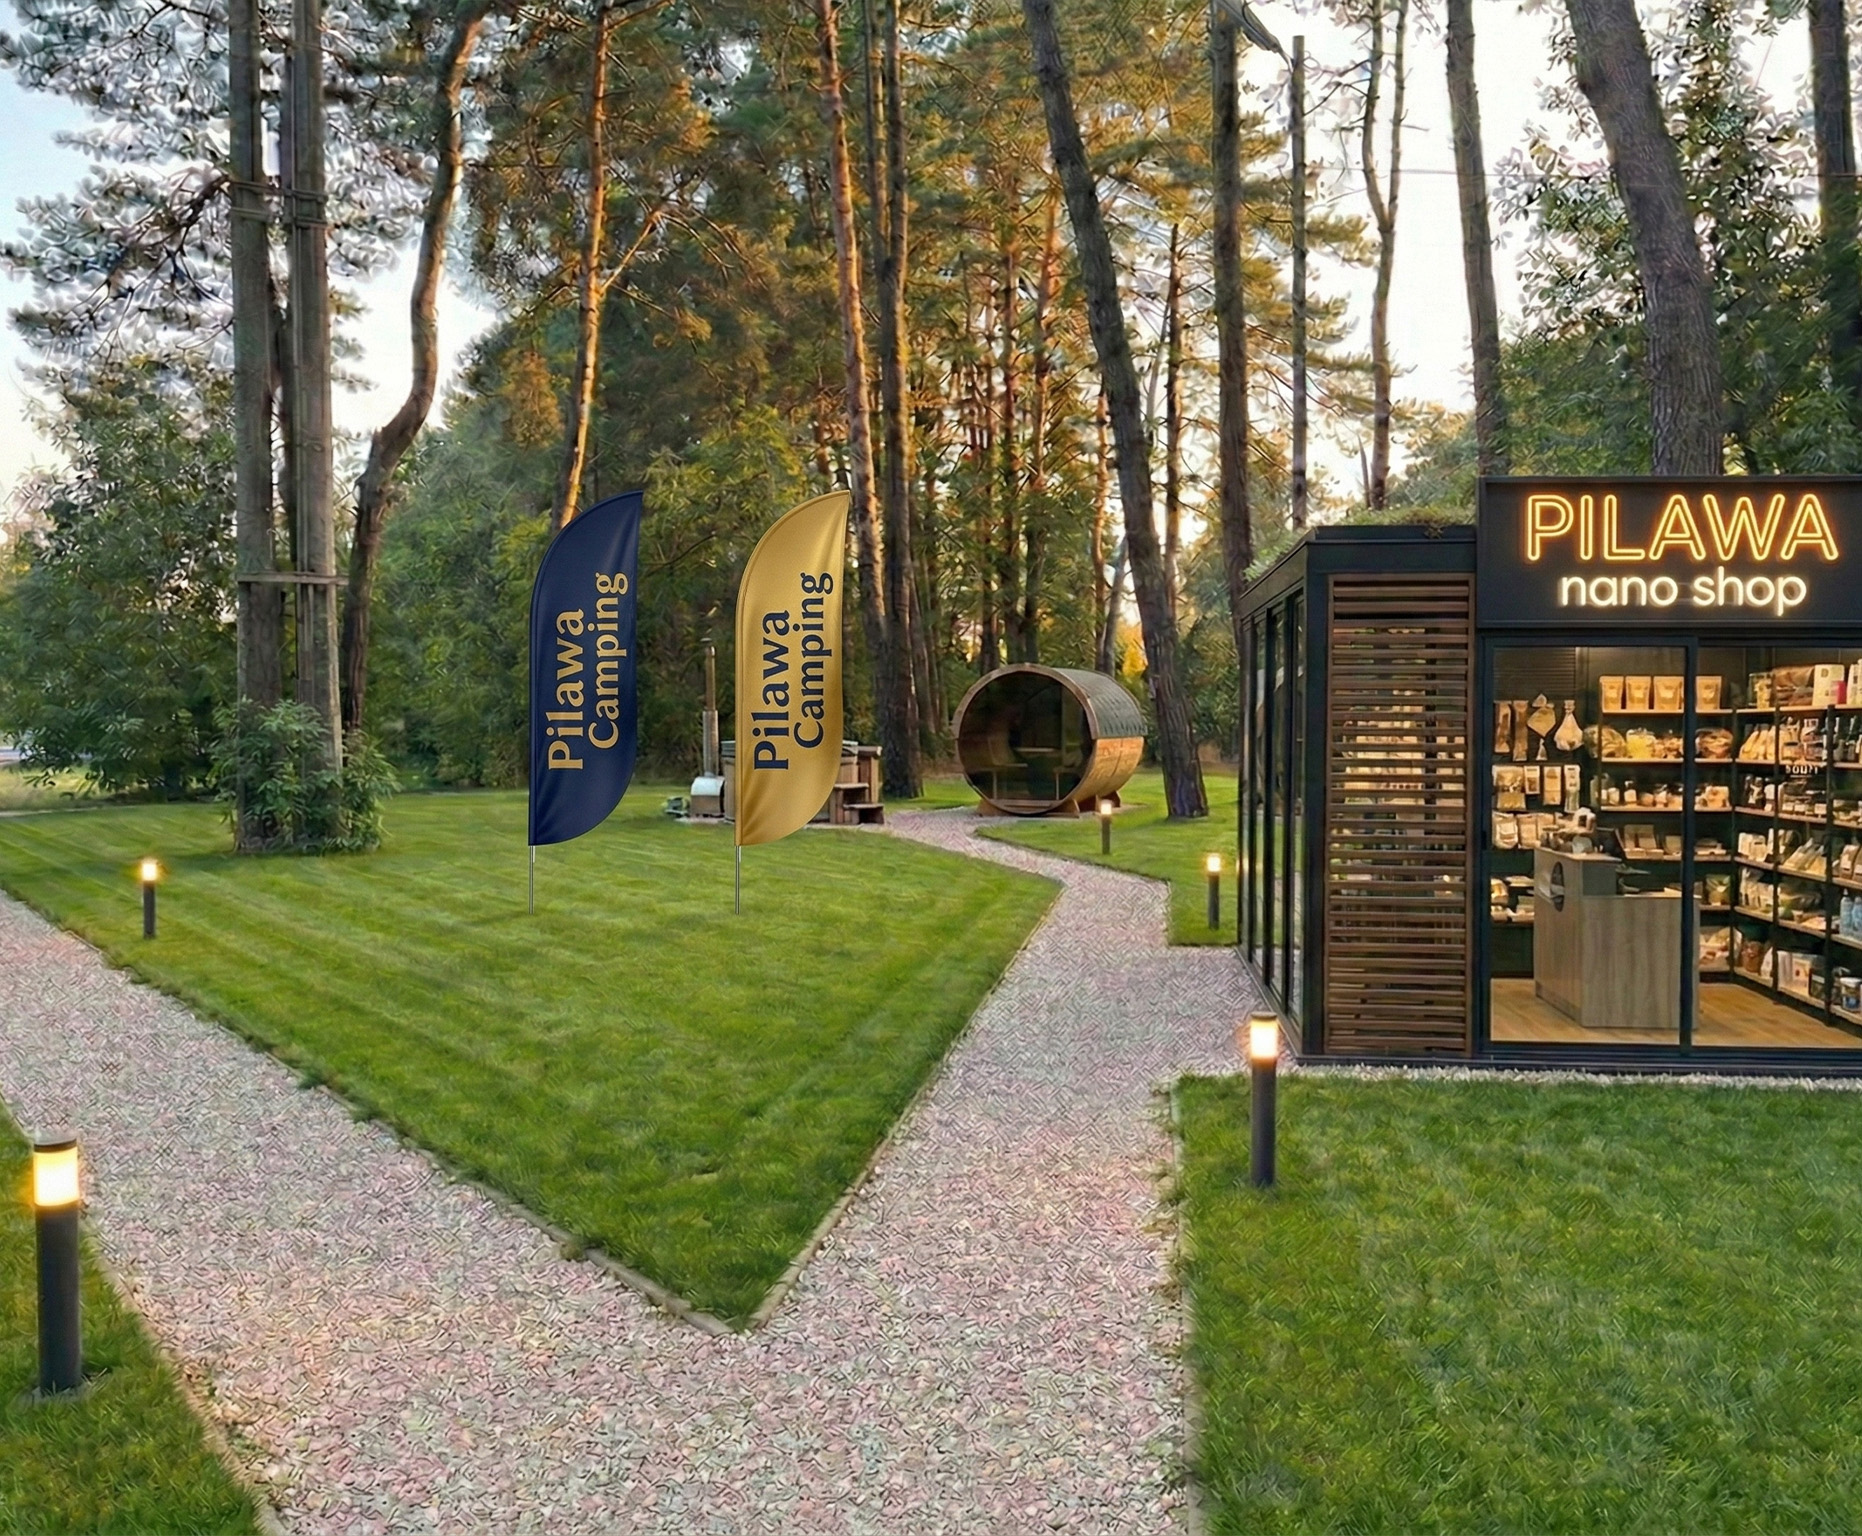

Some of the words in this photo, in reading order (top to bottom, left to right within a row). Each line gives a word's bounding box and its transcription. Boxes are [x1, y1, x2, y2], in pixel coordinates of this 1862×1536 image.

[1527, 494, 1839, 561] PILAWA
[1561, 576, 1679, 606] nano
[1693, 566, 1807, 616] shop
[546, 608, 585, 770] Pilawa
[587, 572, 629, 749] Camping
[751, 610, 790, 770] Pilawa
[793, 572, 834, 749] Camping
